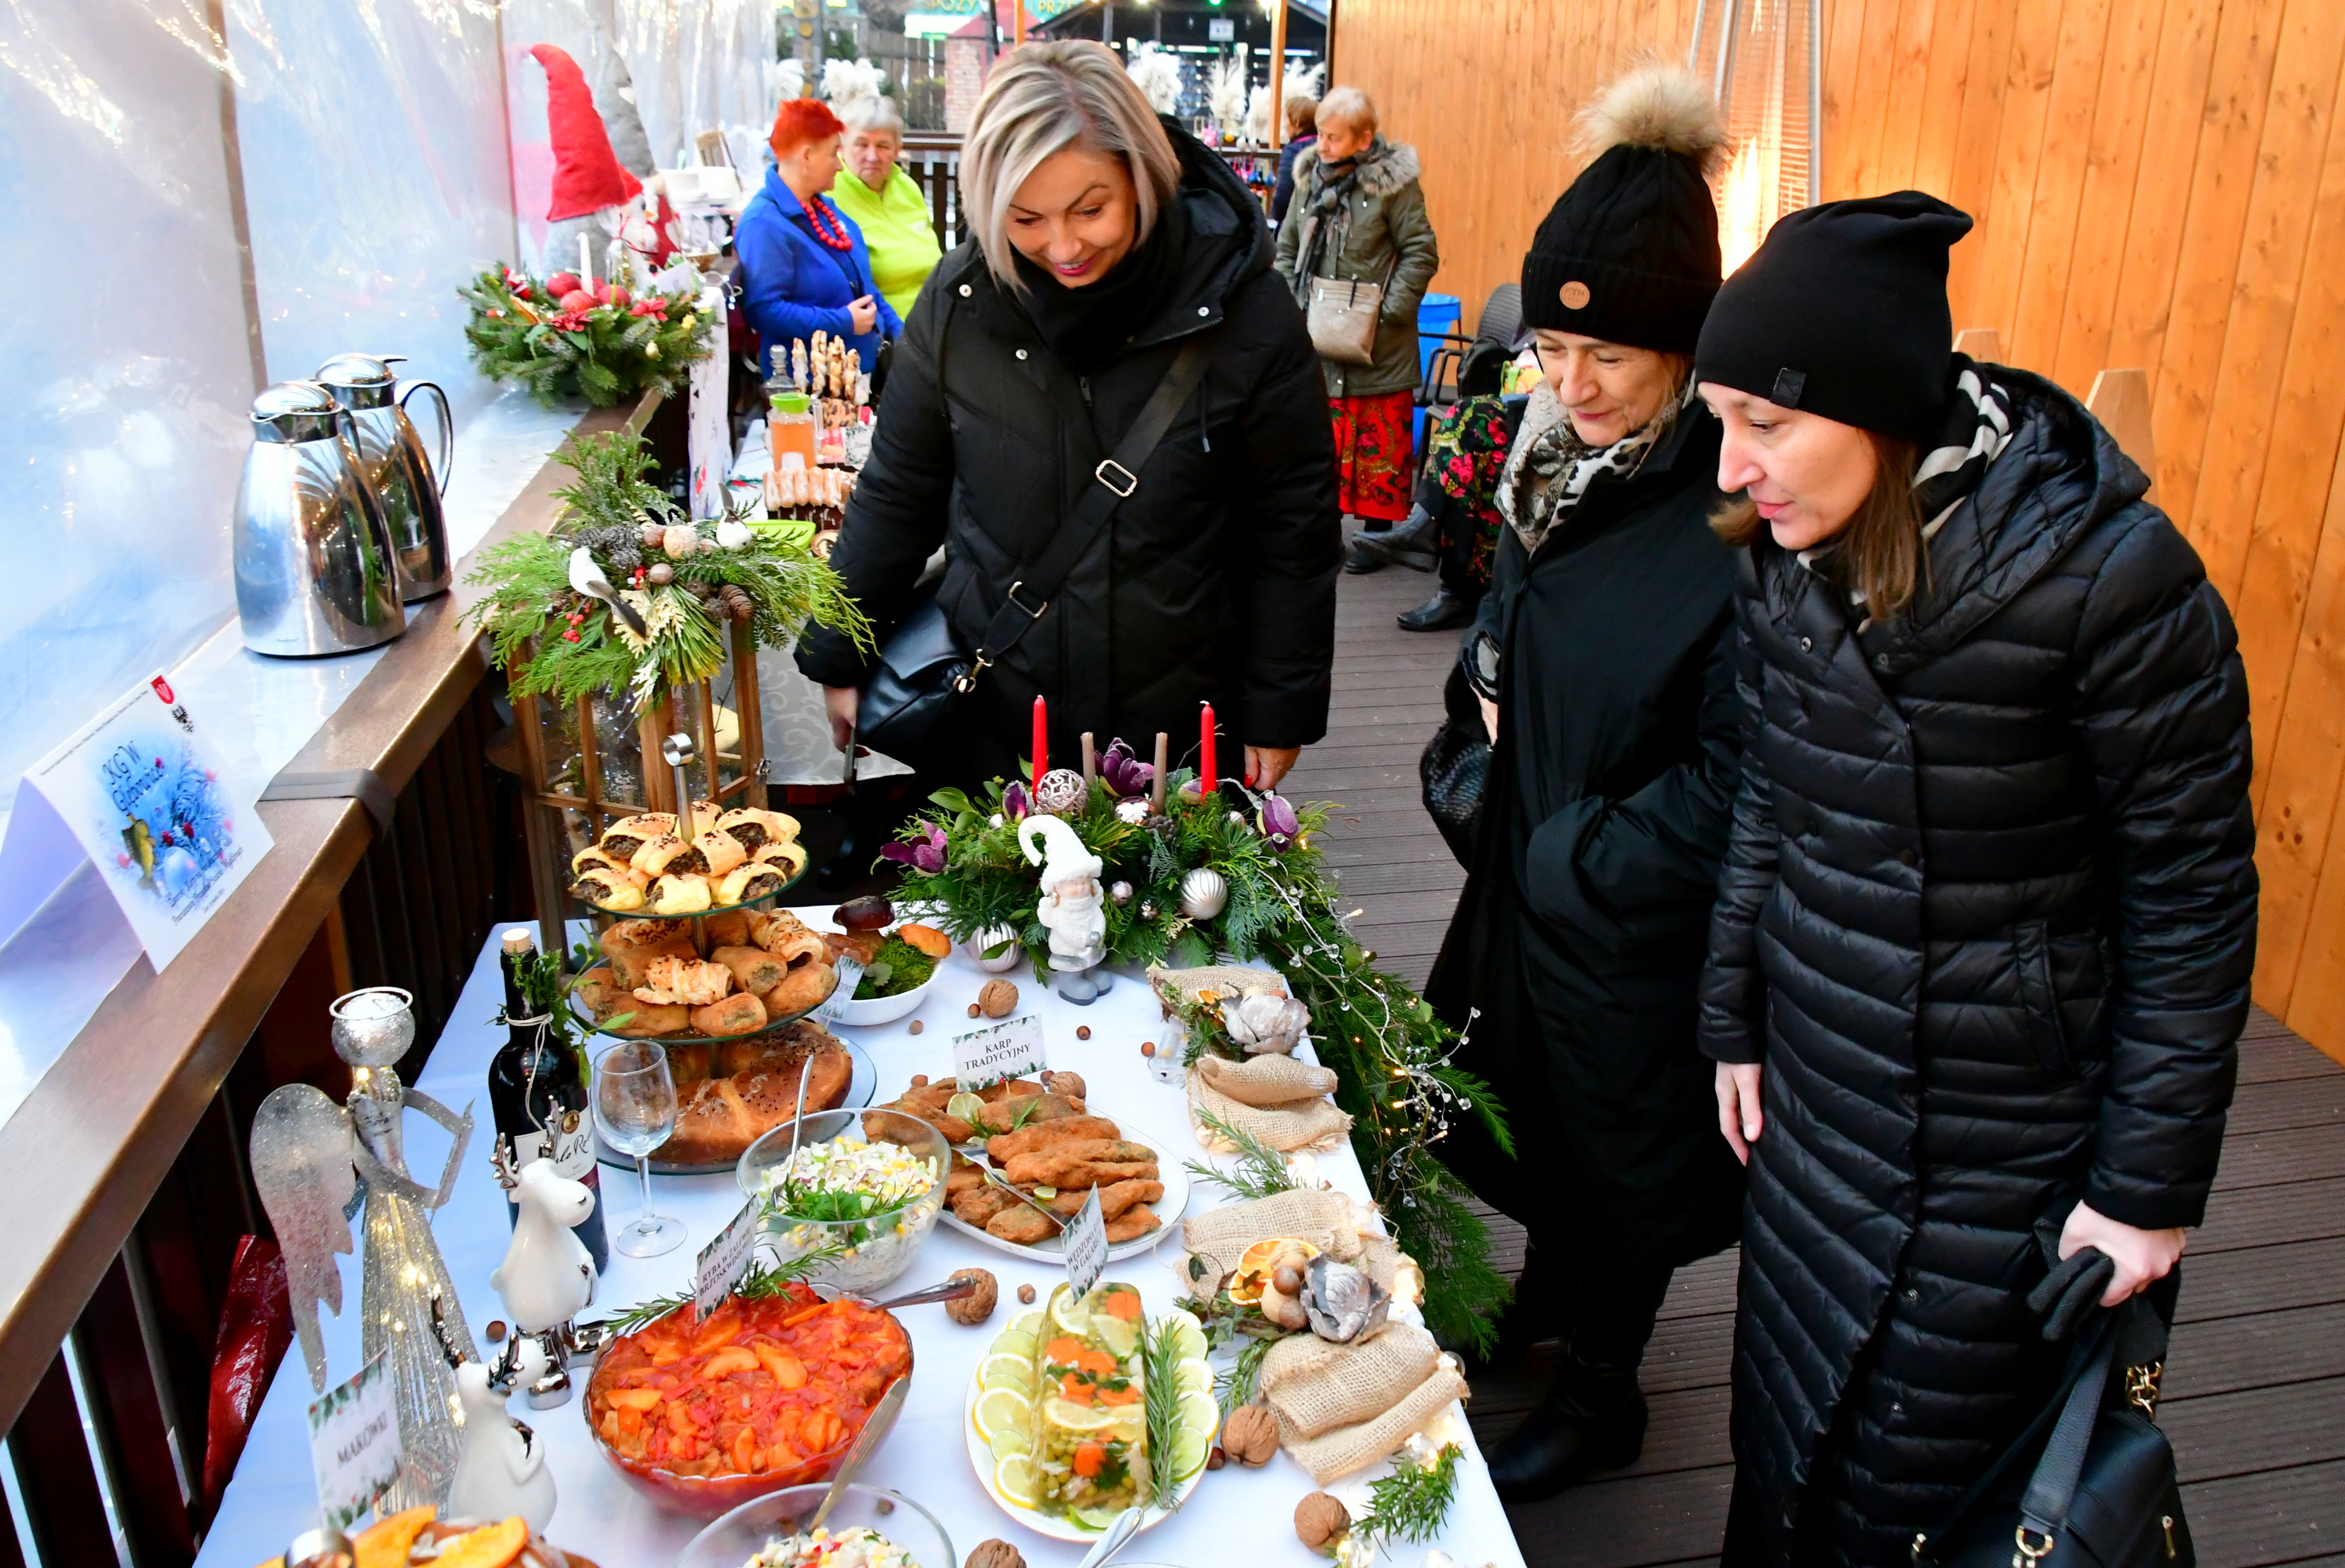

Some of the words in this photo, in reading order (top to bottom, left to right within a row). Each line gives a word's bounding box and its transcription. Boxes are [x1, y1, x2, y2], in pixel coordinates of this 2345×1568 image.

[964, 1043, 1030, 1070] TRADYCYJNY
[986, 1038, 1011, 1054] KARP
[703, 1262, 721, 1283] RYBA
[730, 1225, 751, 1259] ZALEWIE
[1067, 1230, 1094, 1266] WĘDZONA
[1073, 1263, 1079, 1273] W
